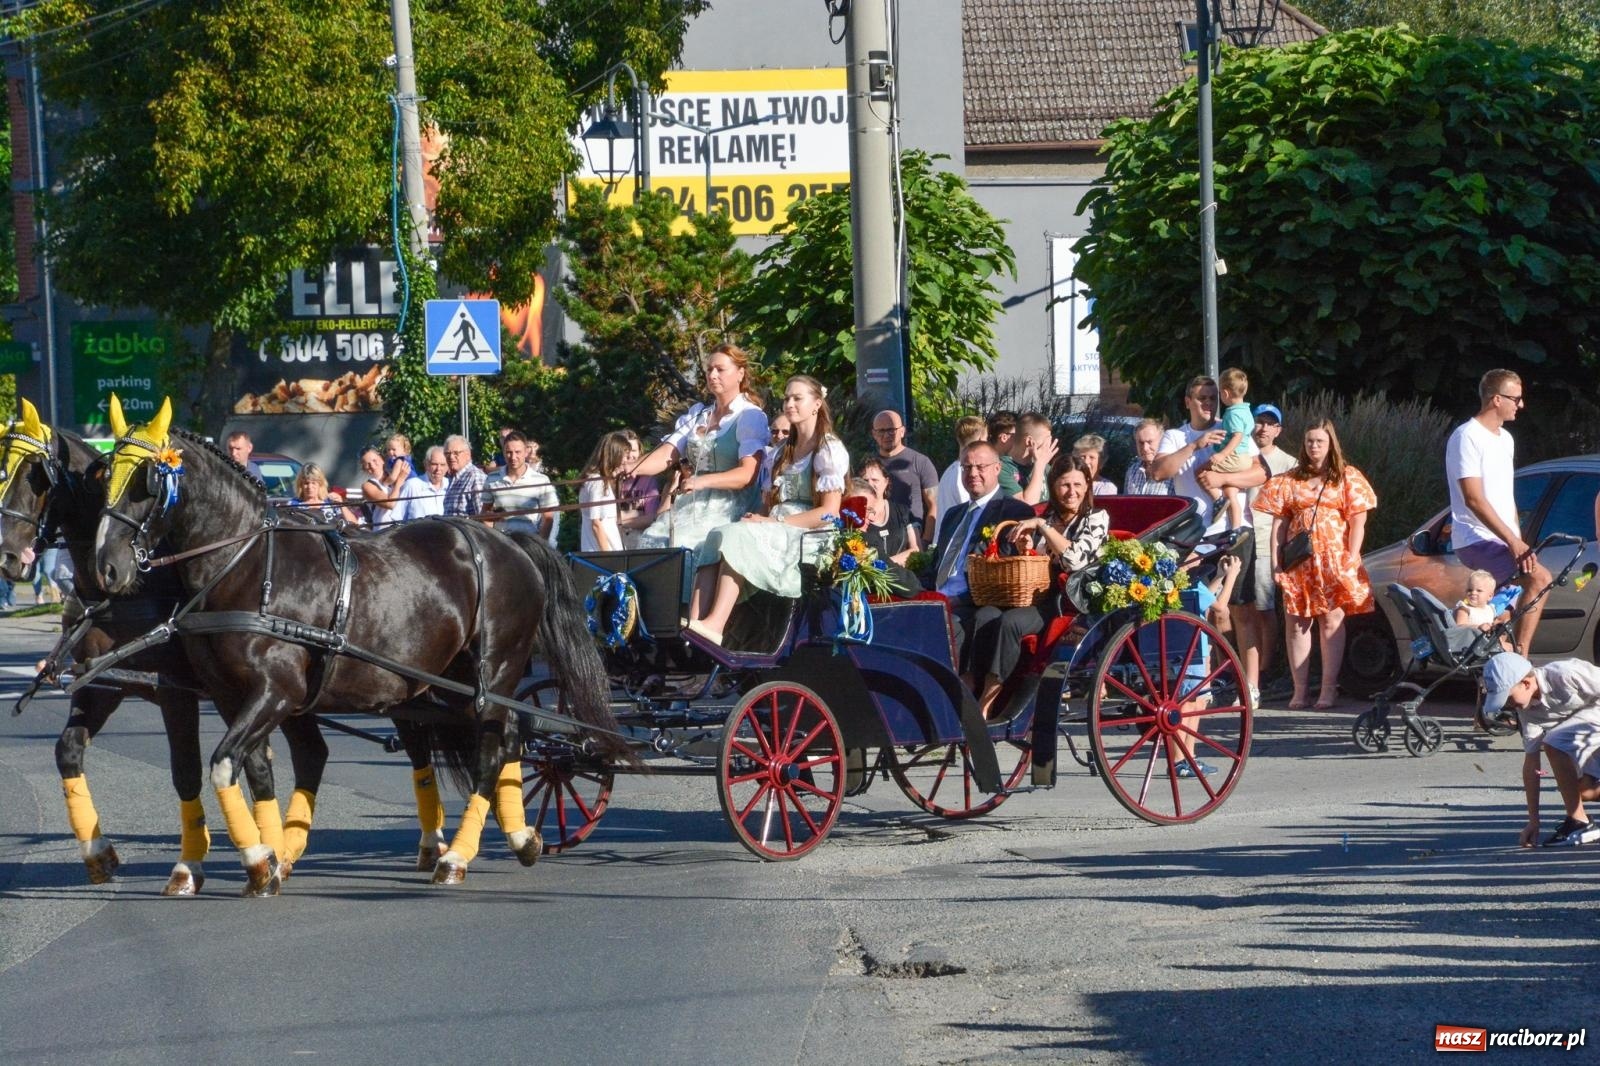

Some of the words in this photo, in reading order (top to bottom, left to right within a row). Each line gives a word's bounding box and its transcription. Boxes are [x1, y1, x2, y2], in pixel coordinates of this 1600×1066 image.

[721, 98, 759, 127] NA
[767, 95, 848, 126] TWOJ
[659, 134, 796, 169] REKLAMĘ!
[709, 184, 774, 222] 506
[83, 332, 165, 354] żabka
[336, 333, 385, 361] 506
[97, 375, 151, 391] parking
[122, 398, 154, 410] 20m
